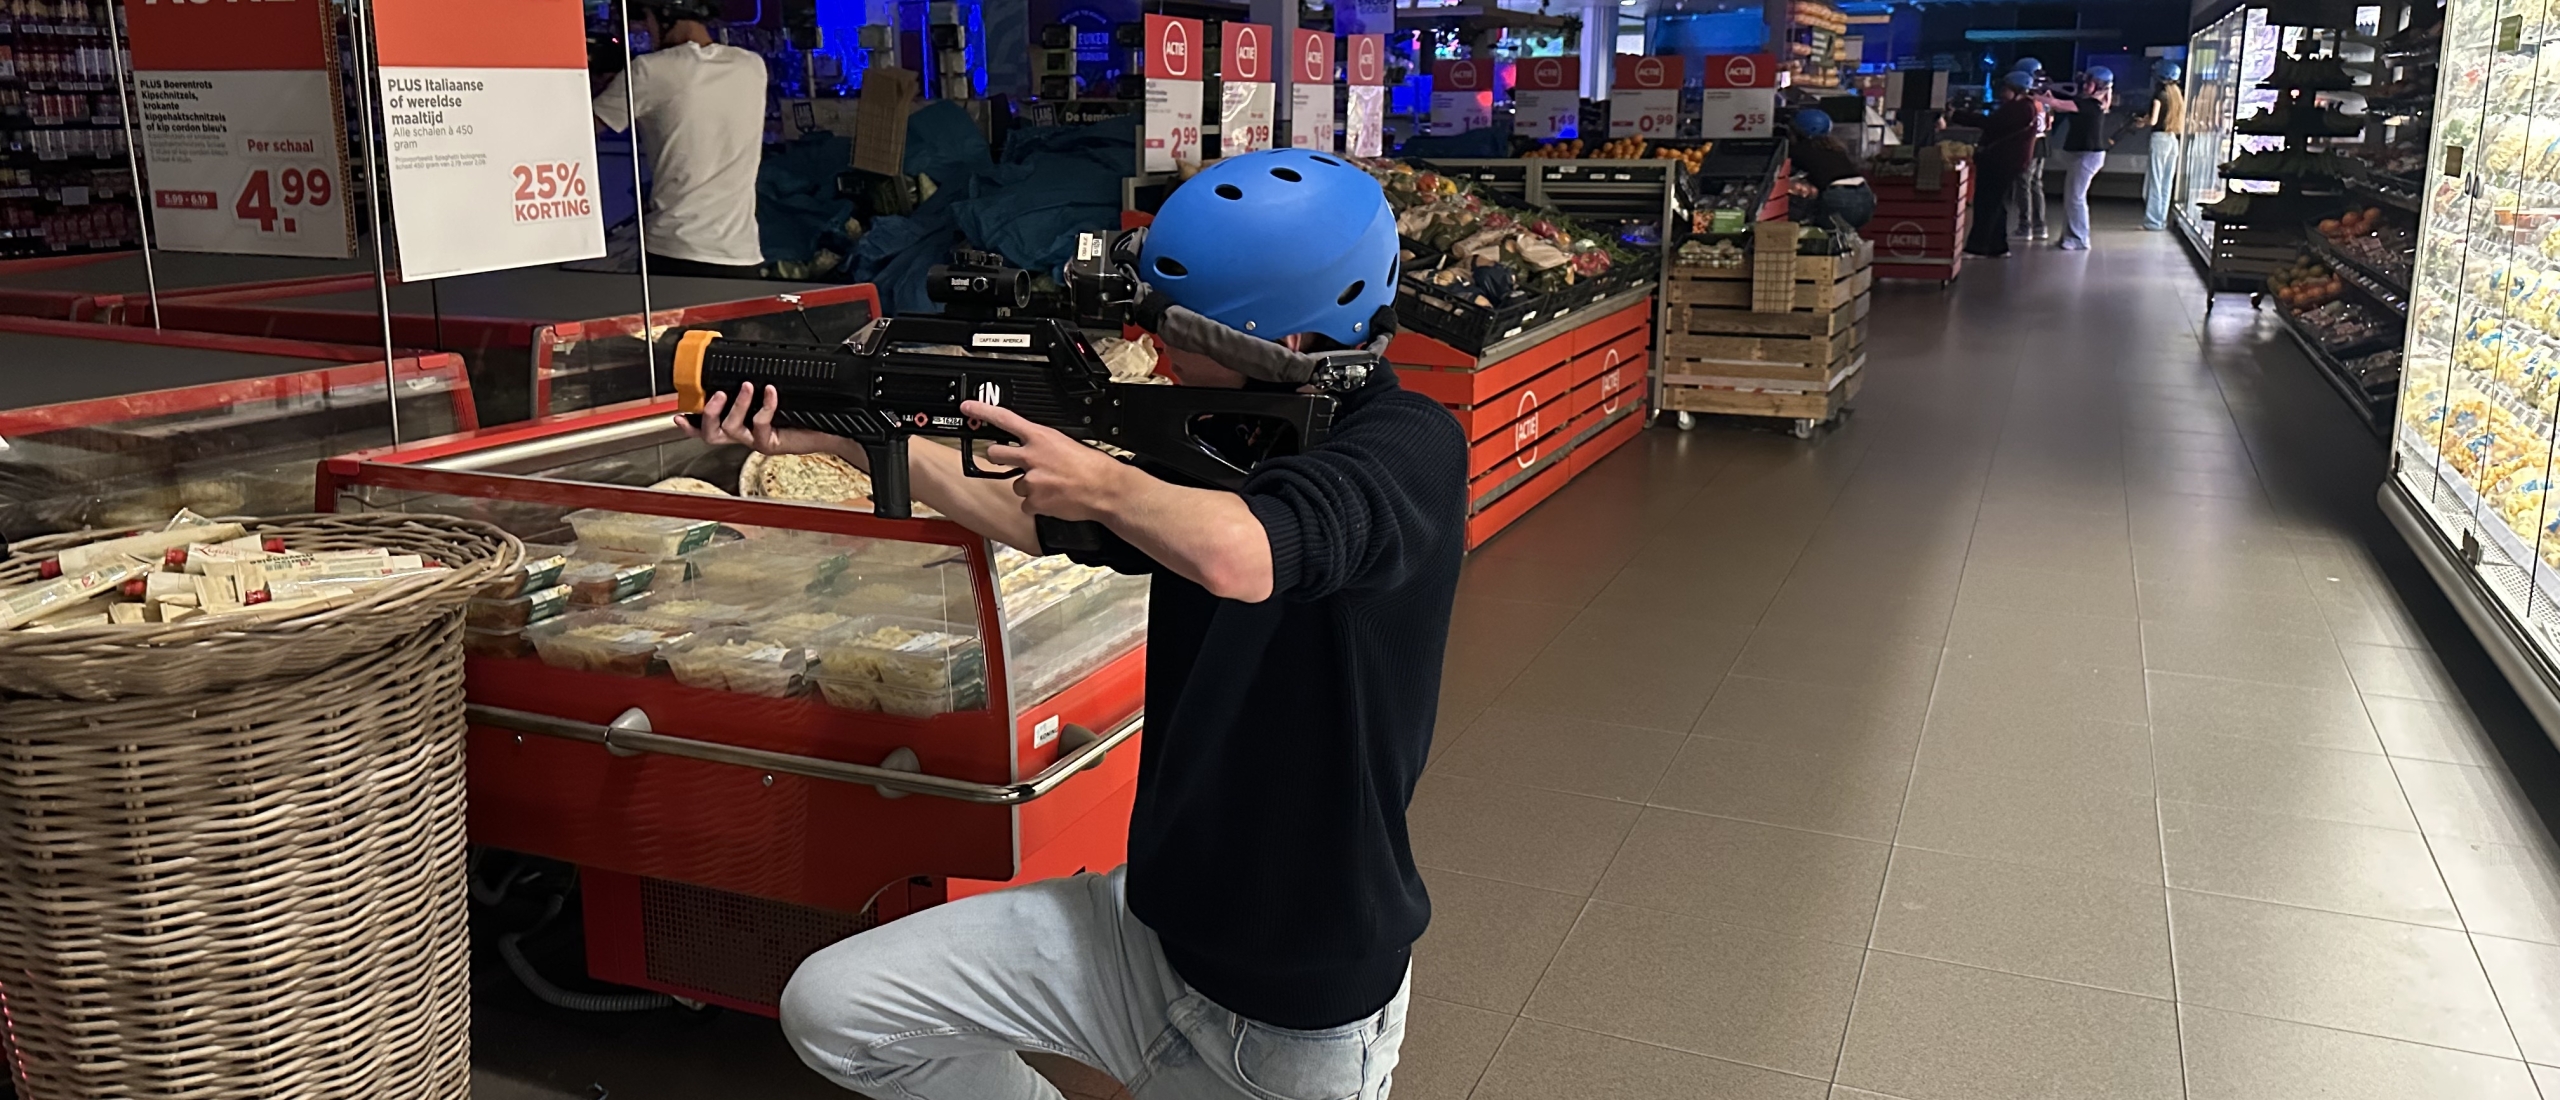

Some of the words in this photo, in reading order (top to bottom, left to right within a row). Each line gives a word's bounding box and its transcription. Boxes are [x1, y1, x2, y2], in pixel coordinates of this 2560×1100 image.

[1166, 42, 1185, 56] ACTIE
[1239, 47, 1255, 60] ACTIE
[1453, 70, 1473, 79] ACTIE
[1537, 68, 1558, 77] ACTIE
[1637, 67, 1661, 77] ACTIE
[1729, 67, 1751, 76] ACTIE
[140, 80, 161, 89] PLUS
[163, 80, 213, 90] Boerentrots
[388, 79, 422, 92] PLUS
[425, 78, 484, 92] Italiaanse
[141, 90, 198, 101] Kipschnitzels,
[389, 95, 403, 108] of
[406, 95, 462, 108] wereldse
[143, 101, 179, 110] krokante
[144, 112, 226, 122] kipgehaktschnitzels
[391, 111, 443, 127] maaltijd
[1066, 111, 1080, 122] De
[146, 123, 155, 132] of
[156, 123, 170, 133] kip
[171, 123, 201, 132] cordon
[202, 123, 228, 133] bleu's
[1639, 114, 1674, 132] 0.99
[1733, 114, 1766, 132] 2.55
[393, 127, 411, 137] Alle
[413, 126, 446, 137] schalen
[456, 125, 473, 135] 450
[247, 138, 270, 152] Per
[273, 138, 314, 153] schaal
[394, 139, 418, 151] gram
[1171, 127, 1198, 158] 2.99
[513, 162, 586, 201] 25%
[236, 168, 331, 233] 4.99
[515, 199, 590, 222] KORTING
[1891, 234, 1922, 246] ACTIE
[1519, 416, 1536, 440] ACTIE
